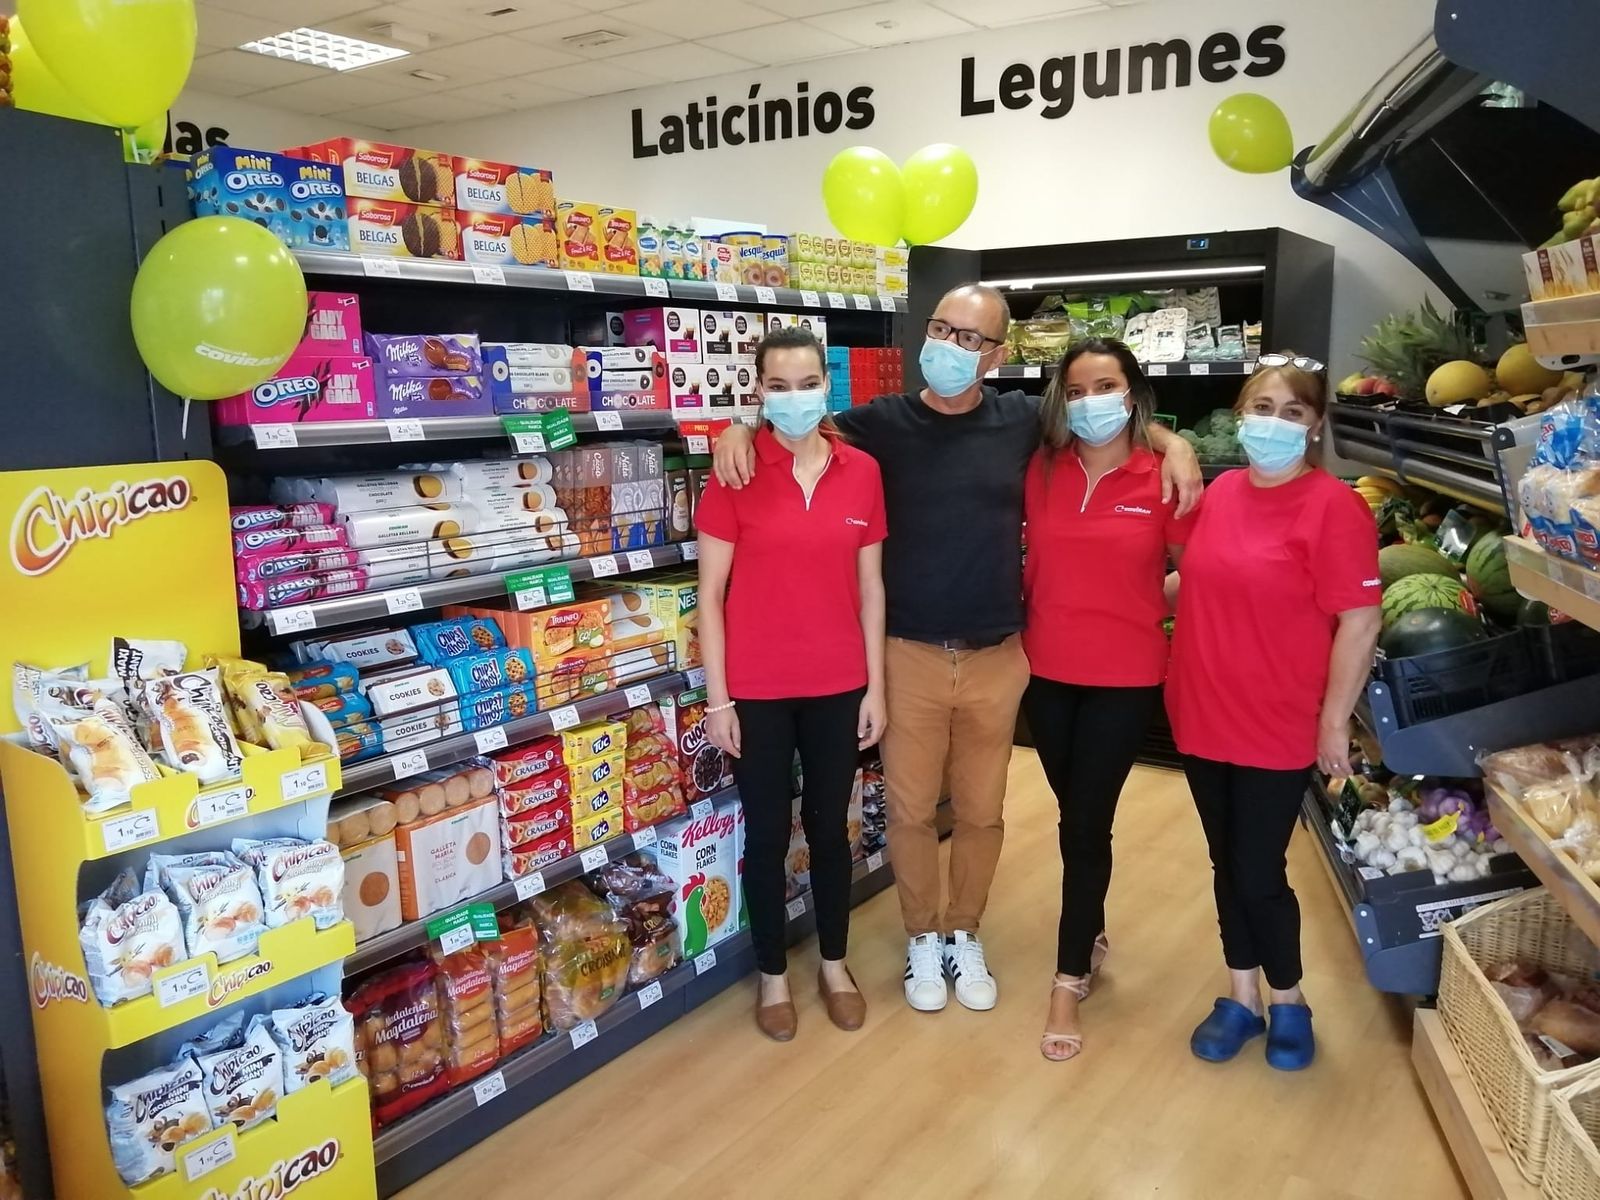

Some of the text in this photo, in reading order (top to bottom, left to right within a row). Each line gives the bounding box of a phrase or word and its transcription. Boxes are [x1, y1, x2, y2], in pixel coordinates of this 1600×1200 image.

[961, 25, 1285, 118] Legumes
[632, 82, 874, 158] Laticínios
[357, 152, 389, 165] Saborosa
[226, 173, 283, 190] OREO
[356, 172, 394, 187] BELGAS
[468, 168, 497, 181] Saborosa
[291, 183, 341, 199] OREO
[467, 187, 501, 202] BELGAS
[360, 208, 392, 222] Saborosa
[474, 221, 503, 234] Saborosa
[359, 230, 397, 244] BELGAS
[473, 240, 507, 253] BELGAS
[386, 339, 419, 362] Milka
[255, 378, 318, 405] OREO
[388, 378, 424, 401] Milka
[10, 475, 190, 576] Chipicao
[232, 510, 282, 530] OREO
[246, 528, 294, 547] OREO
[678, 592, 698, 610] NES
[551, 612, 579, 624] TRIUNFO
[578, 628, 591, 642] GO!
[346, 647, 379, 659] COOKIES
[118, 648, 130, 677] MAXI
[389, 687, 421, 701] COOKIES
[395, 721, 427, 736] COOKIES
[592, 734, 610, 753] TUC
[515, 760, 548, 777] CRACKER
[592, 765, 609, 782] TUC
[523, 789, 556, 806] CRACKER
[592, 793, 608, 810] TUC
[526, 820, 557, 837] CRACKER
[591, 822, 609, 840] TUC
[430, 841, 456, 855] GALLETA
[660, 839, 678, 852] CORN
[660, 849, 678, 859] FLAKES
[696, 842, 717, 861] CORN
[272, 842, 332, 883] Chipicao
[530, 850, 560, 868] CRACKER
[696, 855, 717, 870] FLAKES
[30, 951, 88, 1009] Chipicao
[207, 959, 273, 1008] Chipicao
[385, 1002, 430, 1027] Madalenas
[210, 1045, 260, 1096] Chipicao
[242, 1061, 264, 1076] MINI
[227, 1069, 265, 1091] CROISSANT
[167, 1085, 190, 1100] MINI
[149, 1094, 191, 1116] CROISSANT
